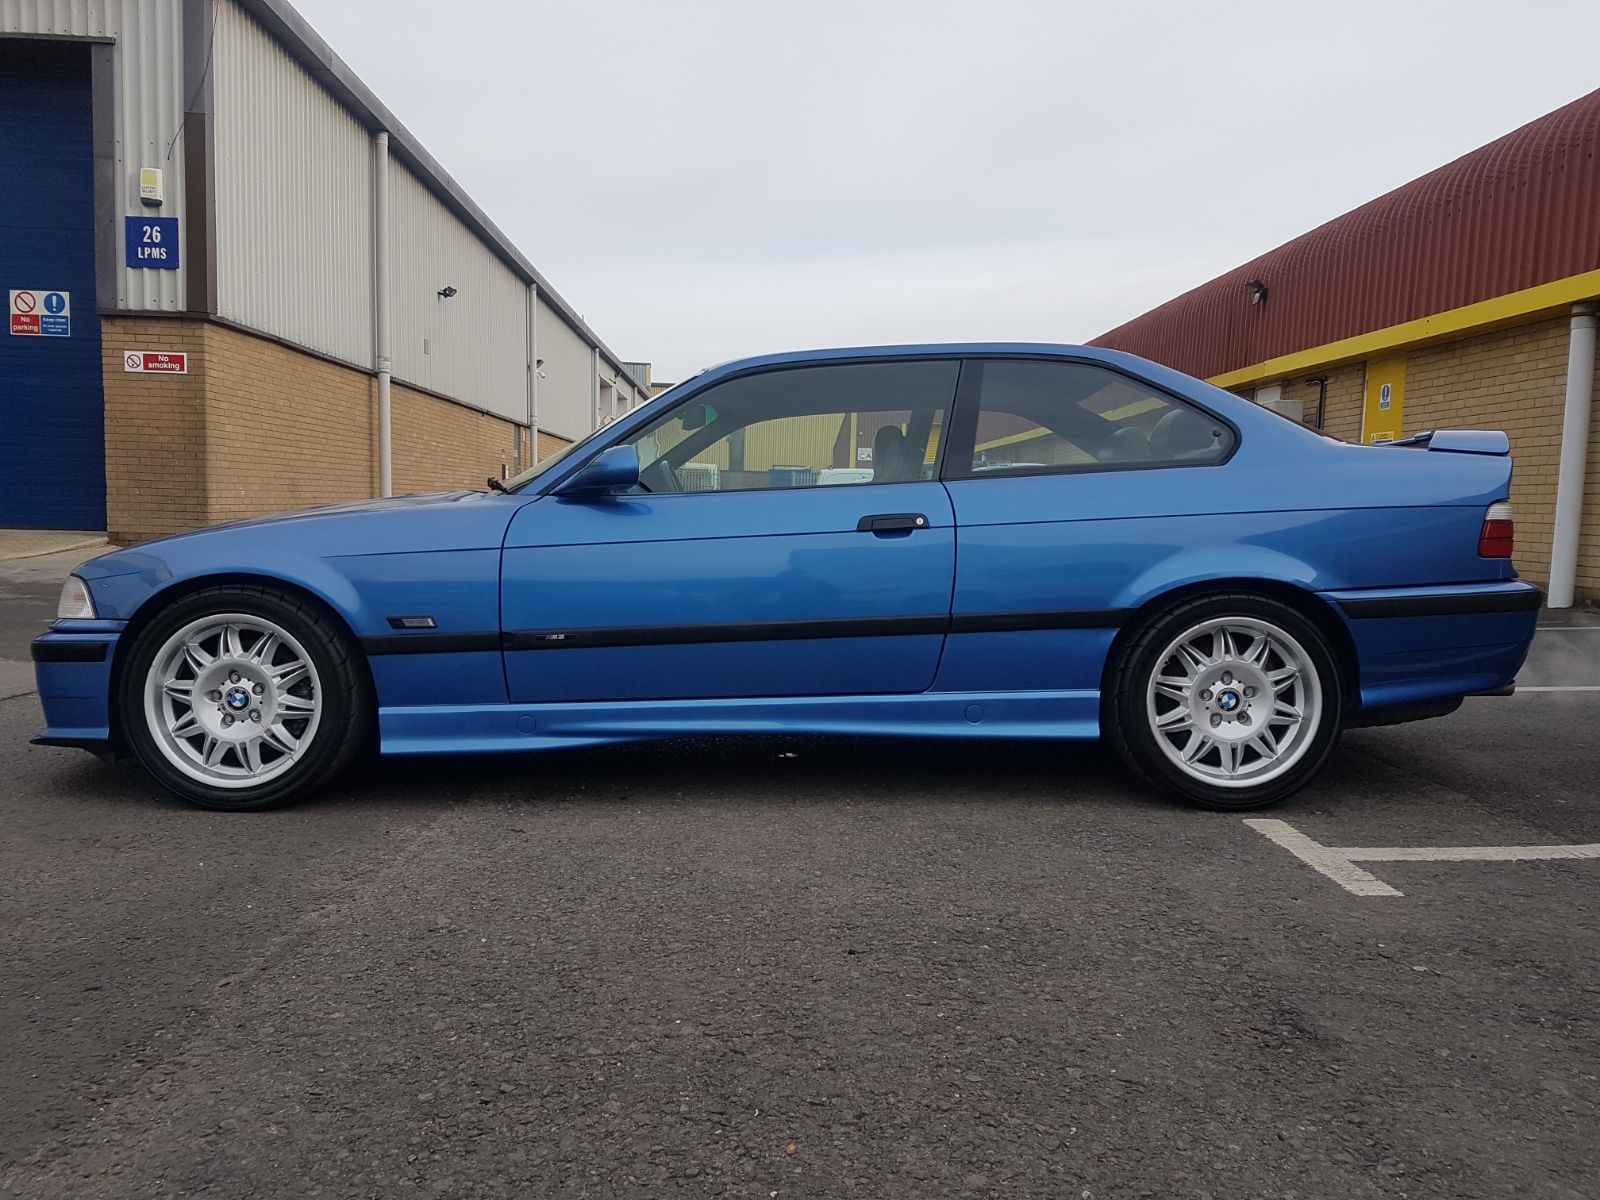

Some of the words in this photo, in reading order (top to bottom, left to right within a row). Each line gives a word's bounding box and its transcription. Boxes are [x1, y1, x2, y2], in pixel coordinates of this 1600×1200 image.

[142, 225, 161, 243] 26
[137, 246, 167, 260] LPMS
[12, 324, 39, 332] parking
[158, 354, 169, 362] No
[147, 362, 180, 370] smoking
